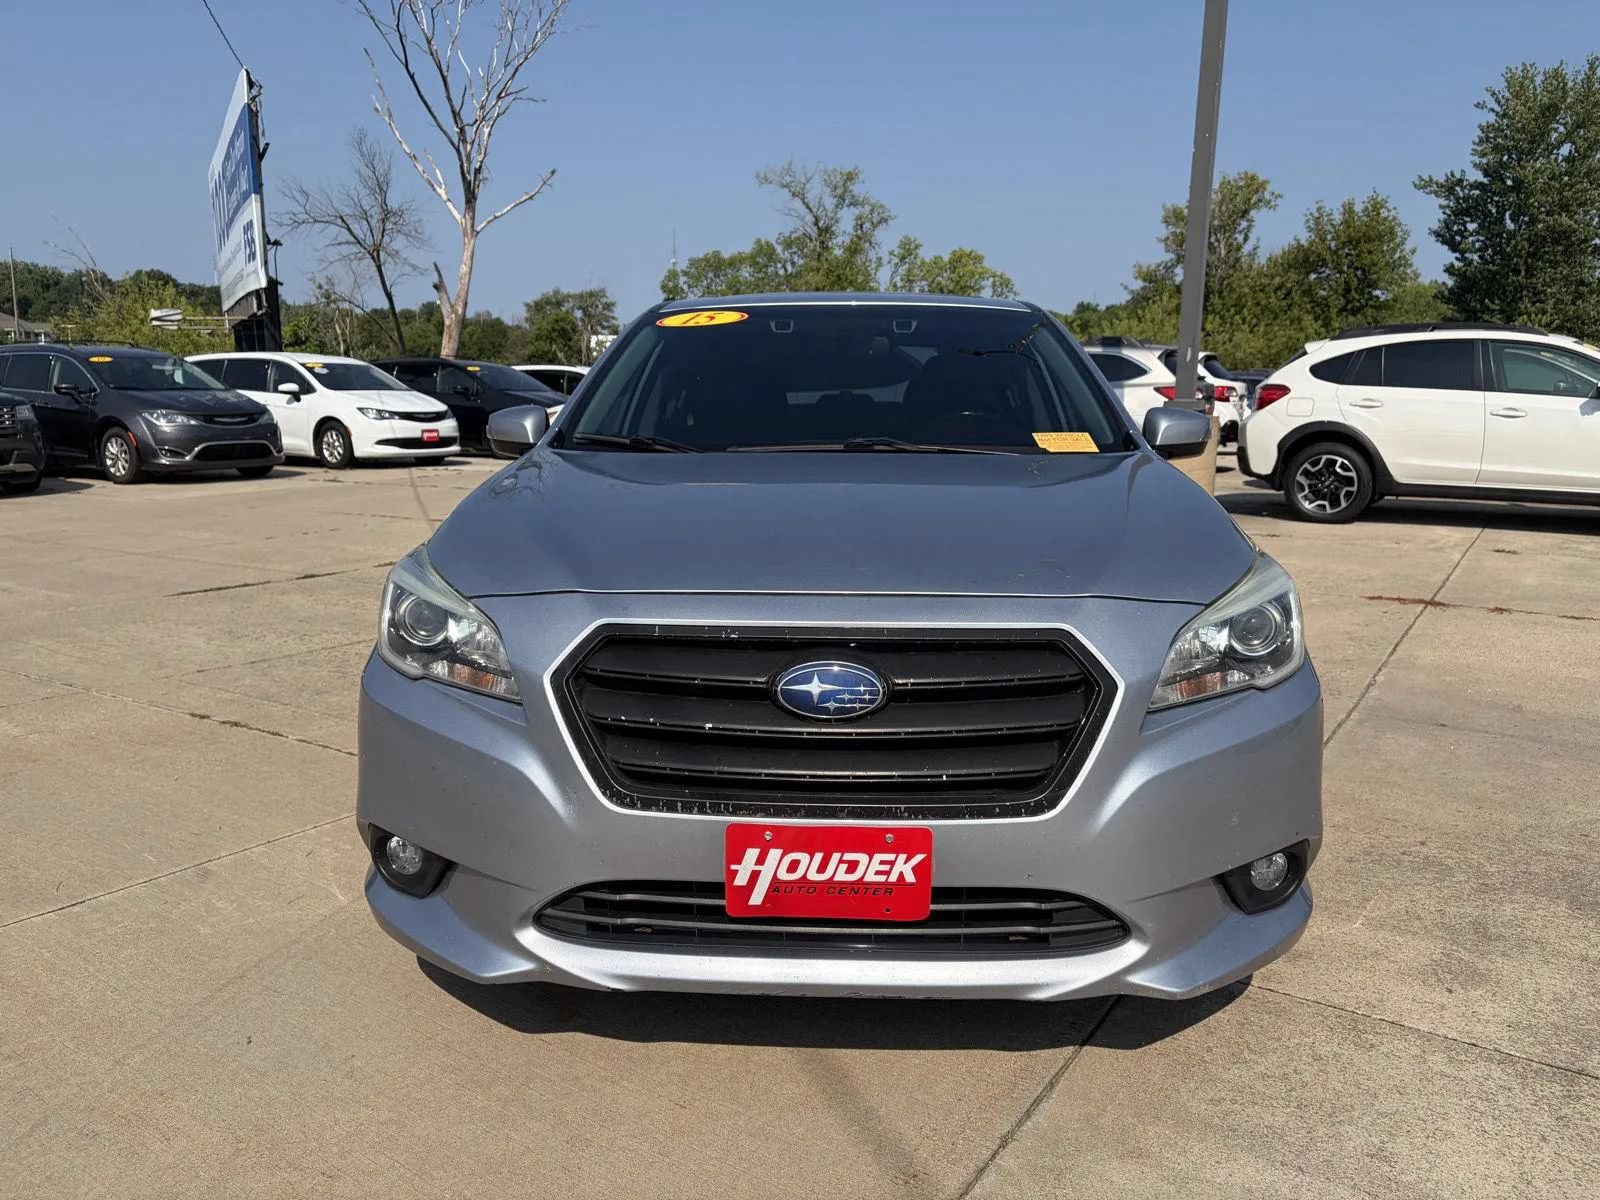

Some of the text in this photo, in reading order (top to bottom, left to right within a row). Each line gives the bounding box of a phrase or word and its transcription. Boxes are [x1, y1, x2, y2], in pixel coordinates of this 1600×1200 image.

[243, 219, 257, 266] FSB
[681, 312, 724, 325] 15
[730, 848, 927, 906] HOUDEK
[771, 885, 894, 897] AUTO CENTER
